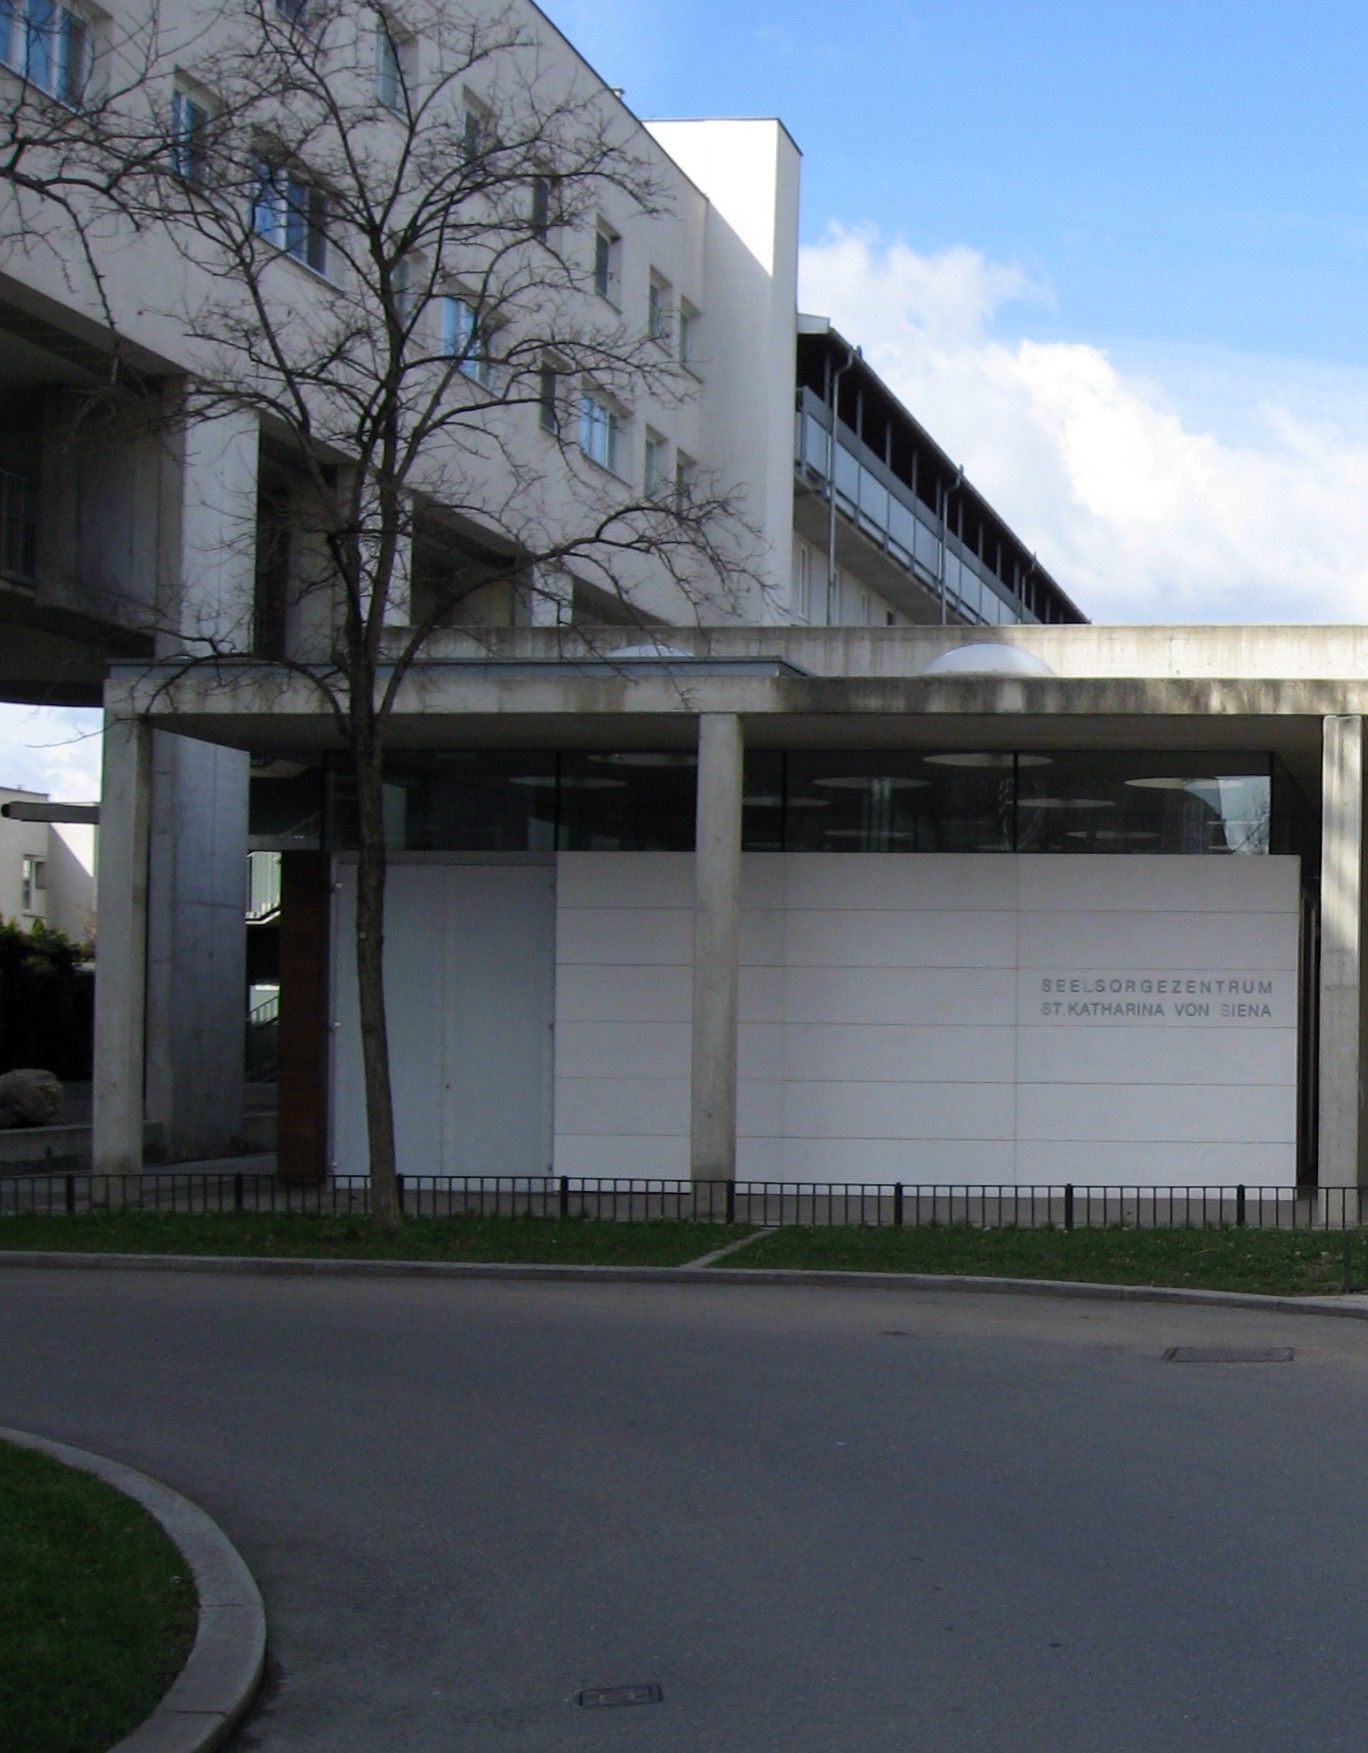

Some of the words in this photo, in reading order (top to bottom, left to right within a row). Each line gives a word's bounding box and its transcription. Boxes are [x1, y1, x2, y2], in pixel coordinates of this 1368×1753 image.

[1041, 979, 1273, 994] SEELSORGEZENTRUM
[1174, 1003, 1210, 1017] VON
[1220, 1003, 1272, 1018] SIENA
